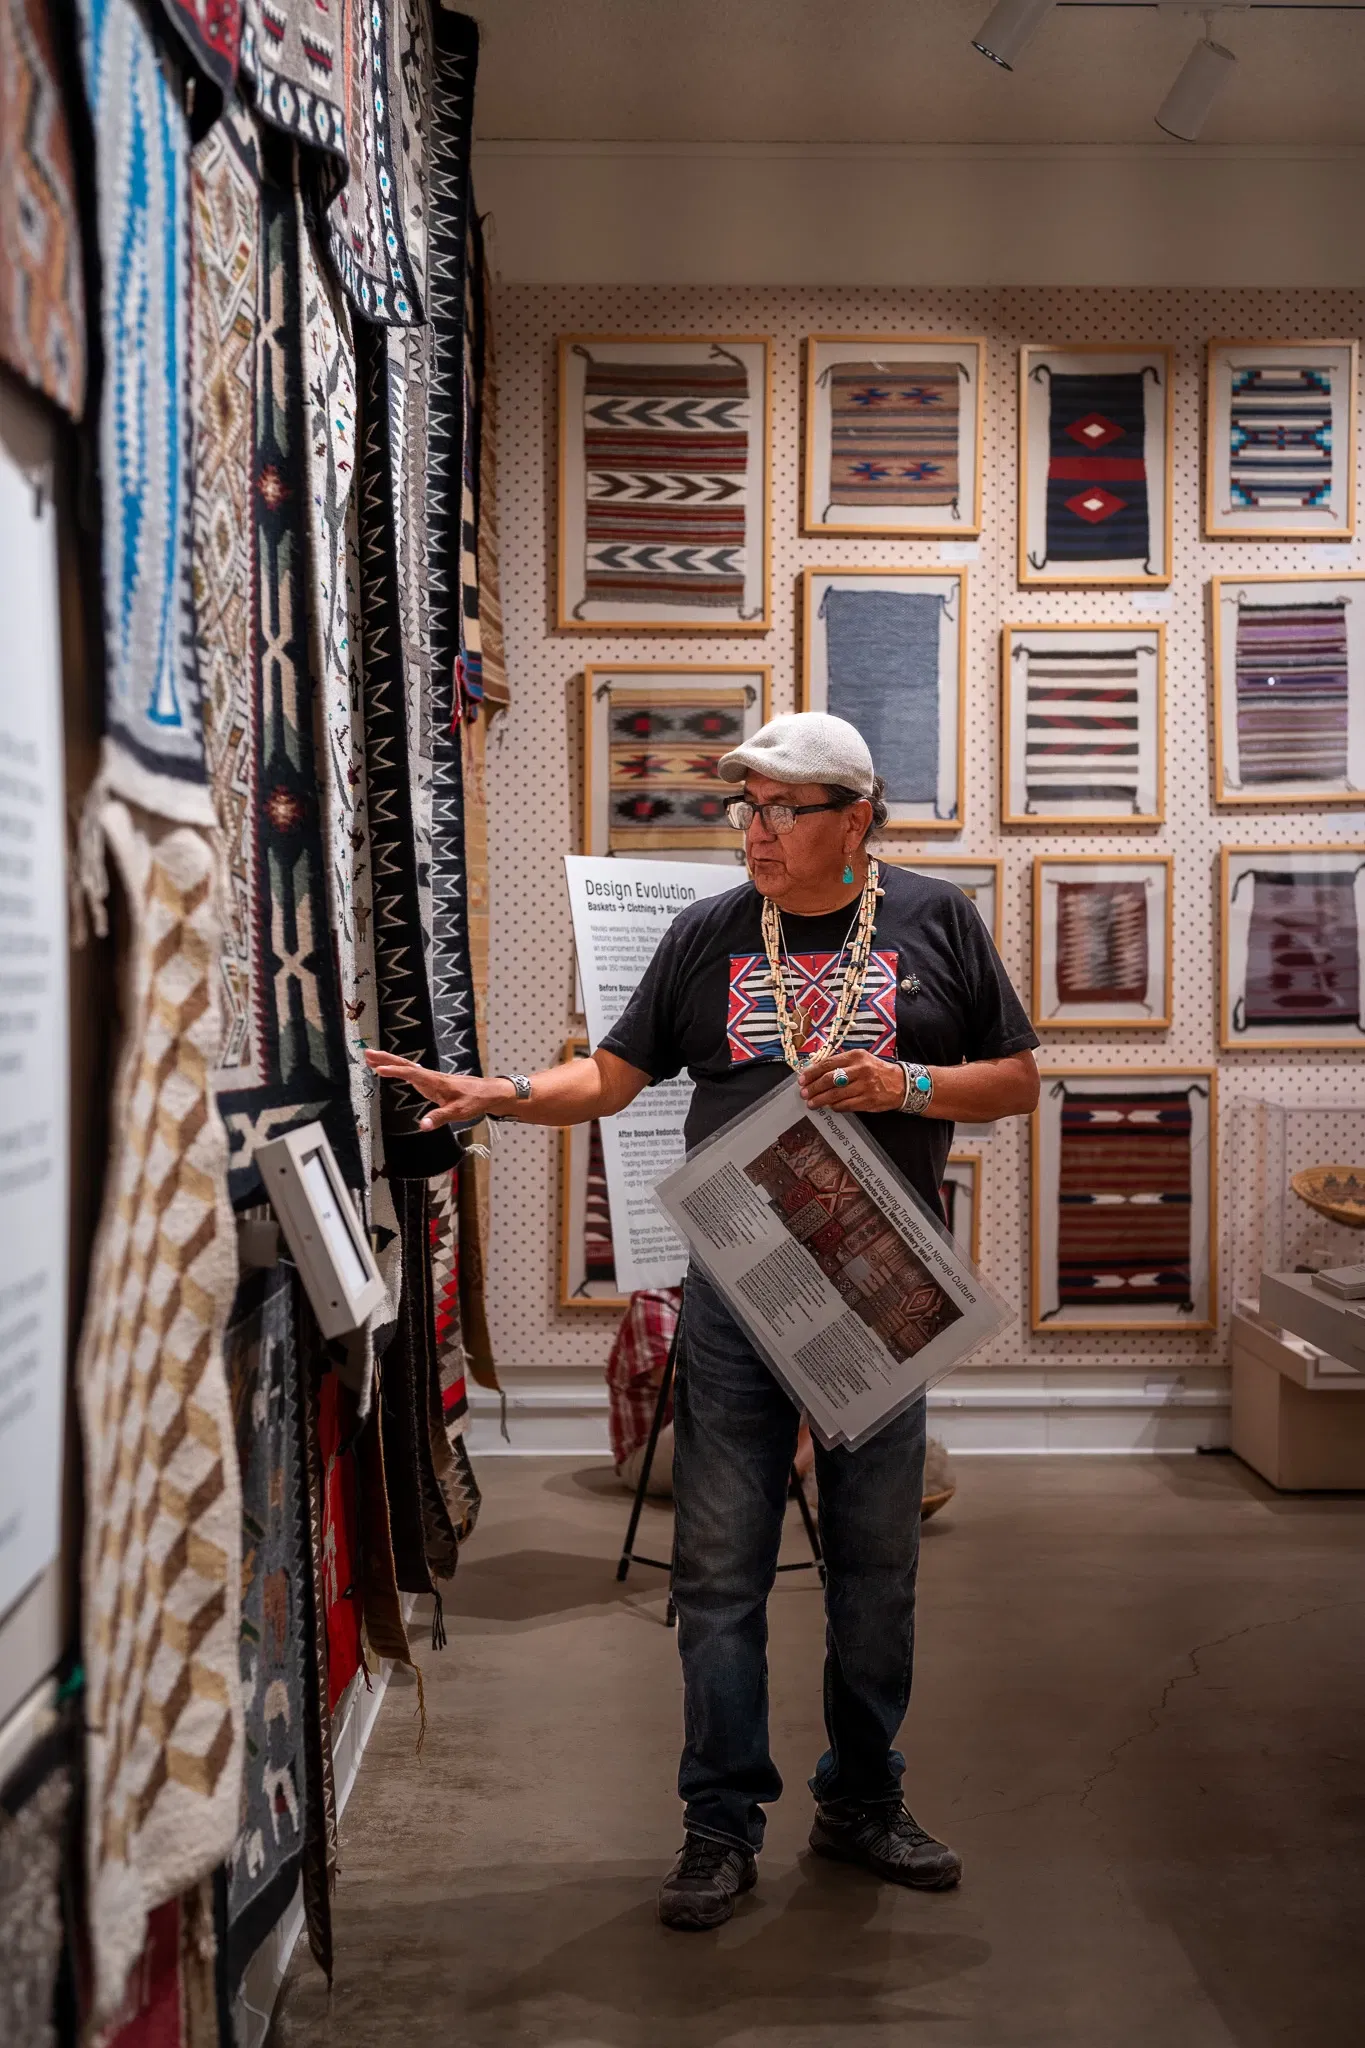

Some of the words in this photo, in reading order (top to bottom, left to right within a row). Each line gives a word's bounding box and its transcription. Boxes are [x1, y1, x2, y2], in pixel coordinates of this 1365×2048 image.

[585, 880, 632, 900] Design
[635, 882, 696, 900] Evolution
[588, 902, 617, 912] Baskets
[627, 903, 657, 915] Clothing
[618, 1129, 632, 1138] After
[633, 1129, 655, 1139] Bosque
[823, 1115, 851, 1147] People's
[846, 1145, 877, 1180] Tapestry:
[872, 1178, 902, 1210] Weaving
[846, 1158, 865, 1179] Textile
[862, 1178, 879, 1197] Photo
[875, 1195, 889, 1210] Key
[888, 1210, 904, 1228] West
[899, 1226, 920, 1250] Gallery
[917, 1247, 931, 1263] Wall
[898, 1208, 928, 1243] Tradition
[924, 1240, 935, 1251] in
[929, 1249, 955, 1278] Navajo
[951, 1275, 977, 1304] Culture
